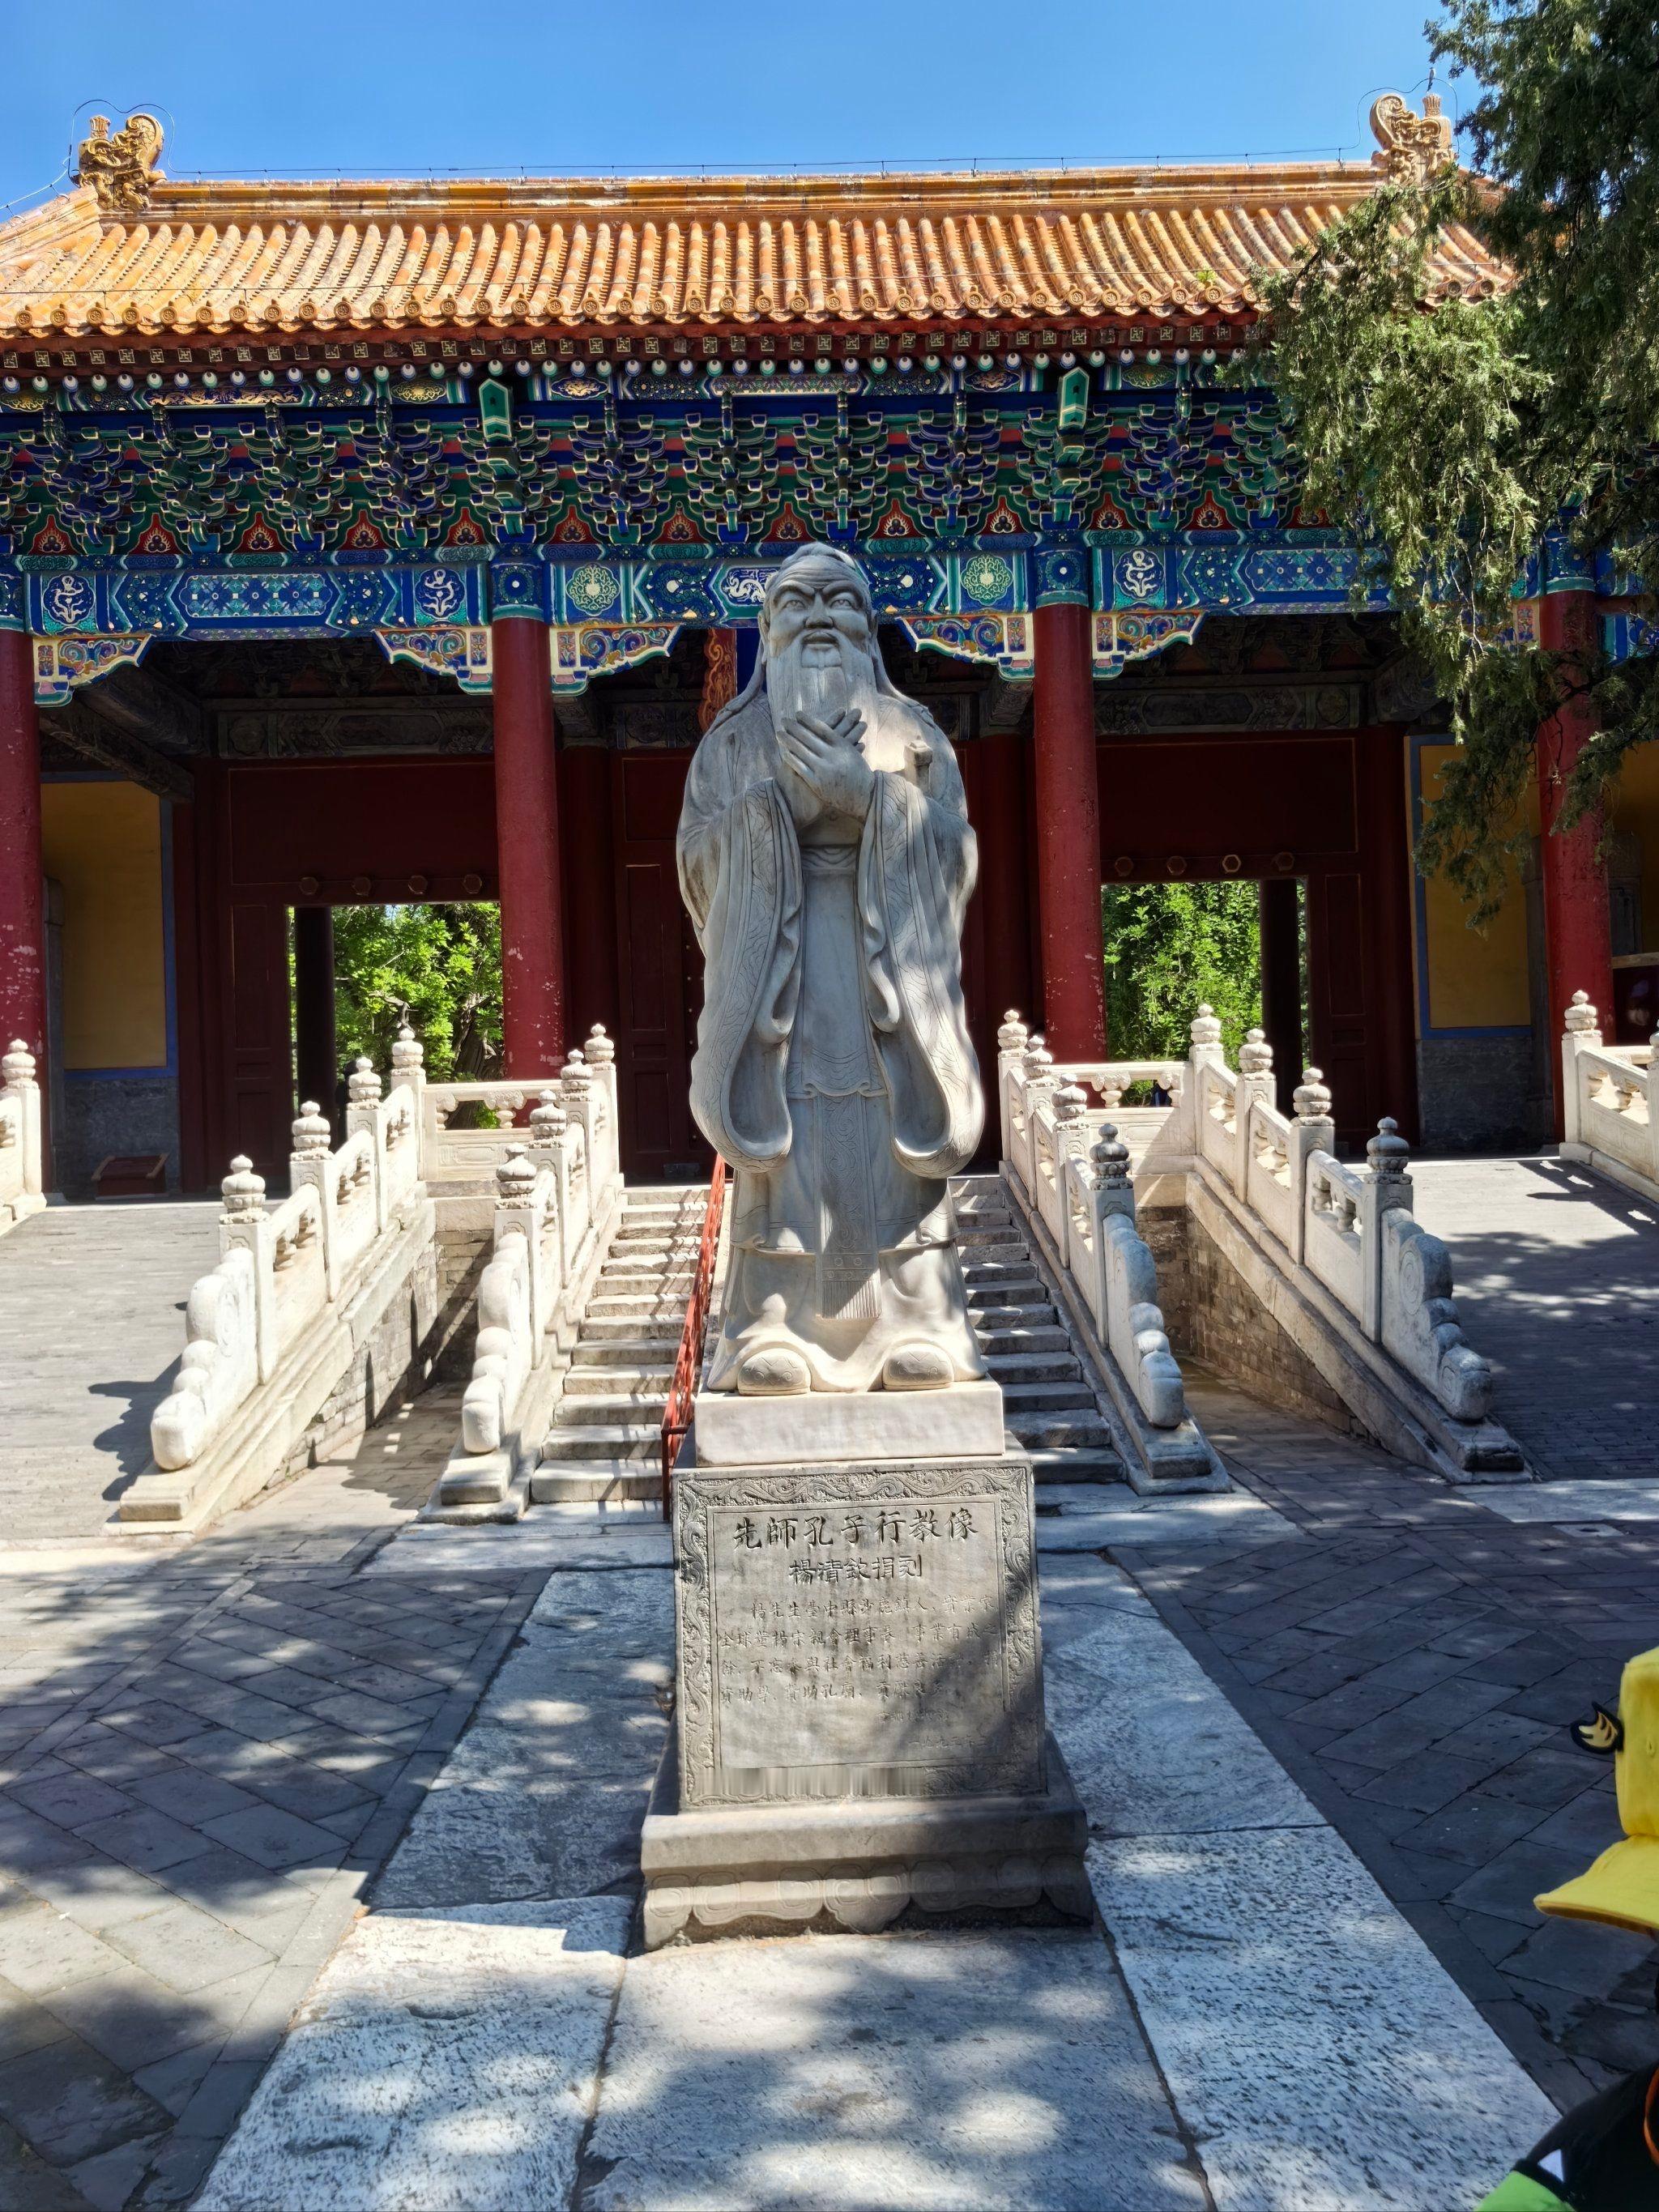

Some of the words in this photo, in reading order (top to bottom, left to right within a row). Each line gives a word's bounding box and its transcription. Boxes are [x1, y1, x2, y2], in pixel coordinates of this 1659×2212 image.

[732, 1507, 979, 1549] 先師孔子行教像
